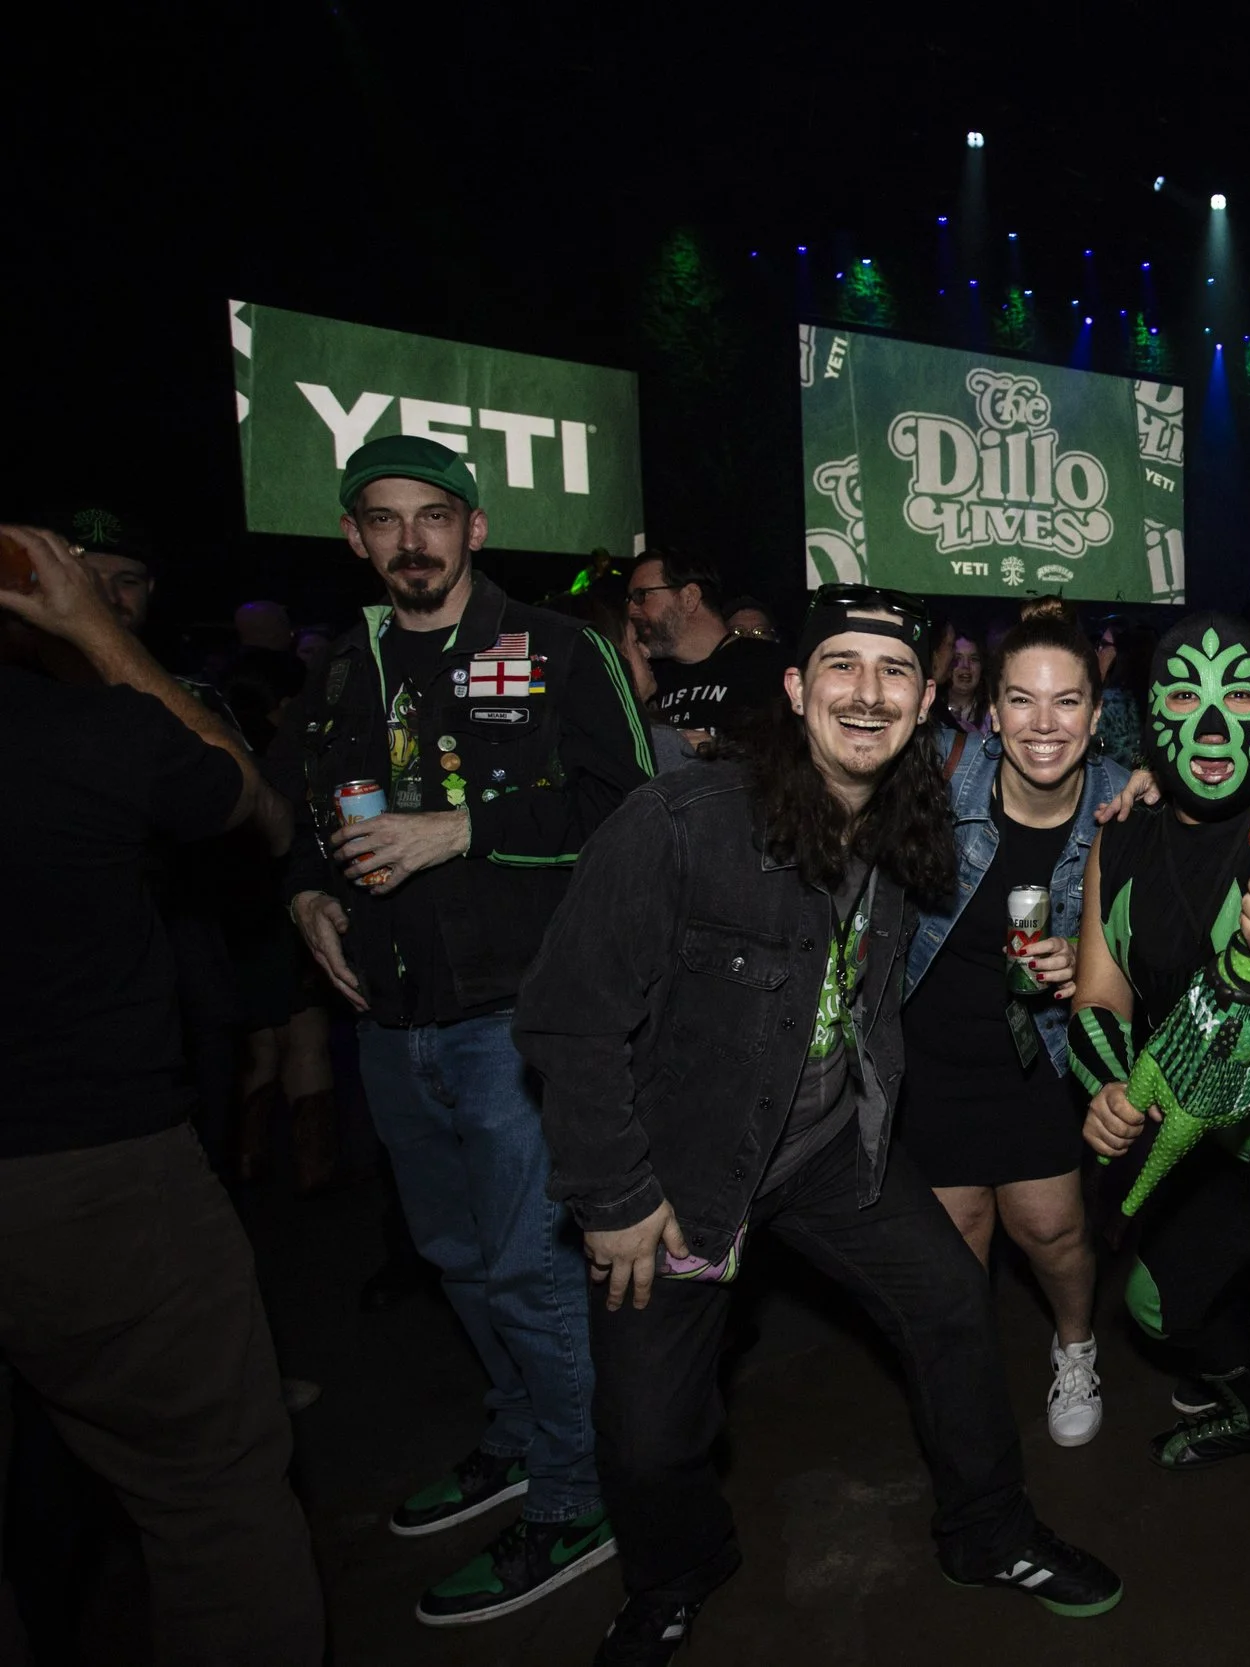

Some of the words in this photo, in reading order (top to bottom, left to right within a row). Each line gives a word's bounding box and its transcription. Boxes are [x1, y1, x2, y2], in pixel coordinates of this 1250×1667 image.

[824, 337, 847, 378] YETI
[966, 368, 1050, 429] The
[295, 382, 590, 494] YETI
[889, 412, 1108, 508] Dillo
[1146, 467, 1175, 493] YETI
[904, 495, 1114, 558] LIVES
[951, 561, 989, 576] YETI
[661, 684, 728, 709] USTIN
[1014, 919, 1038, 929] EQUIS
